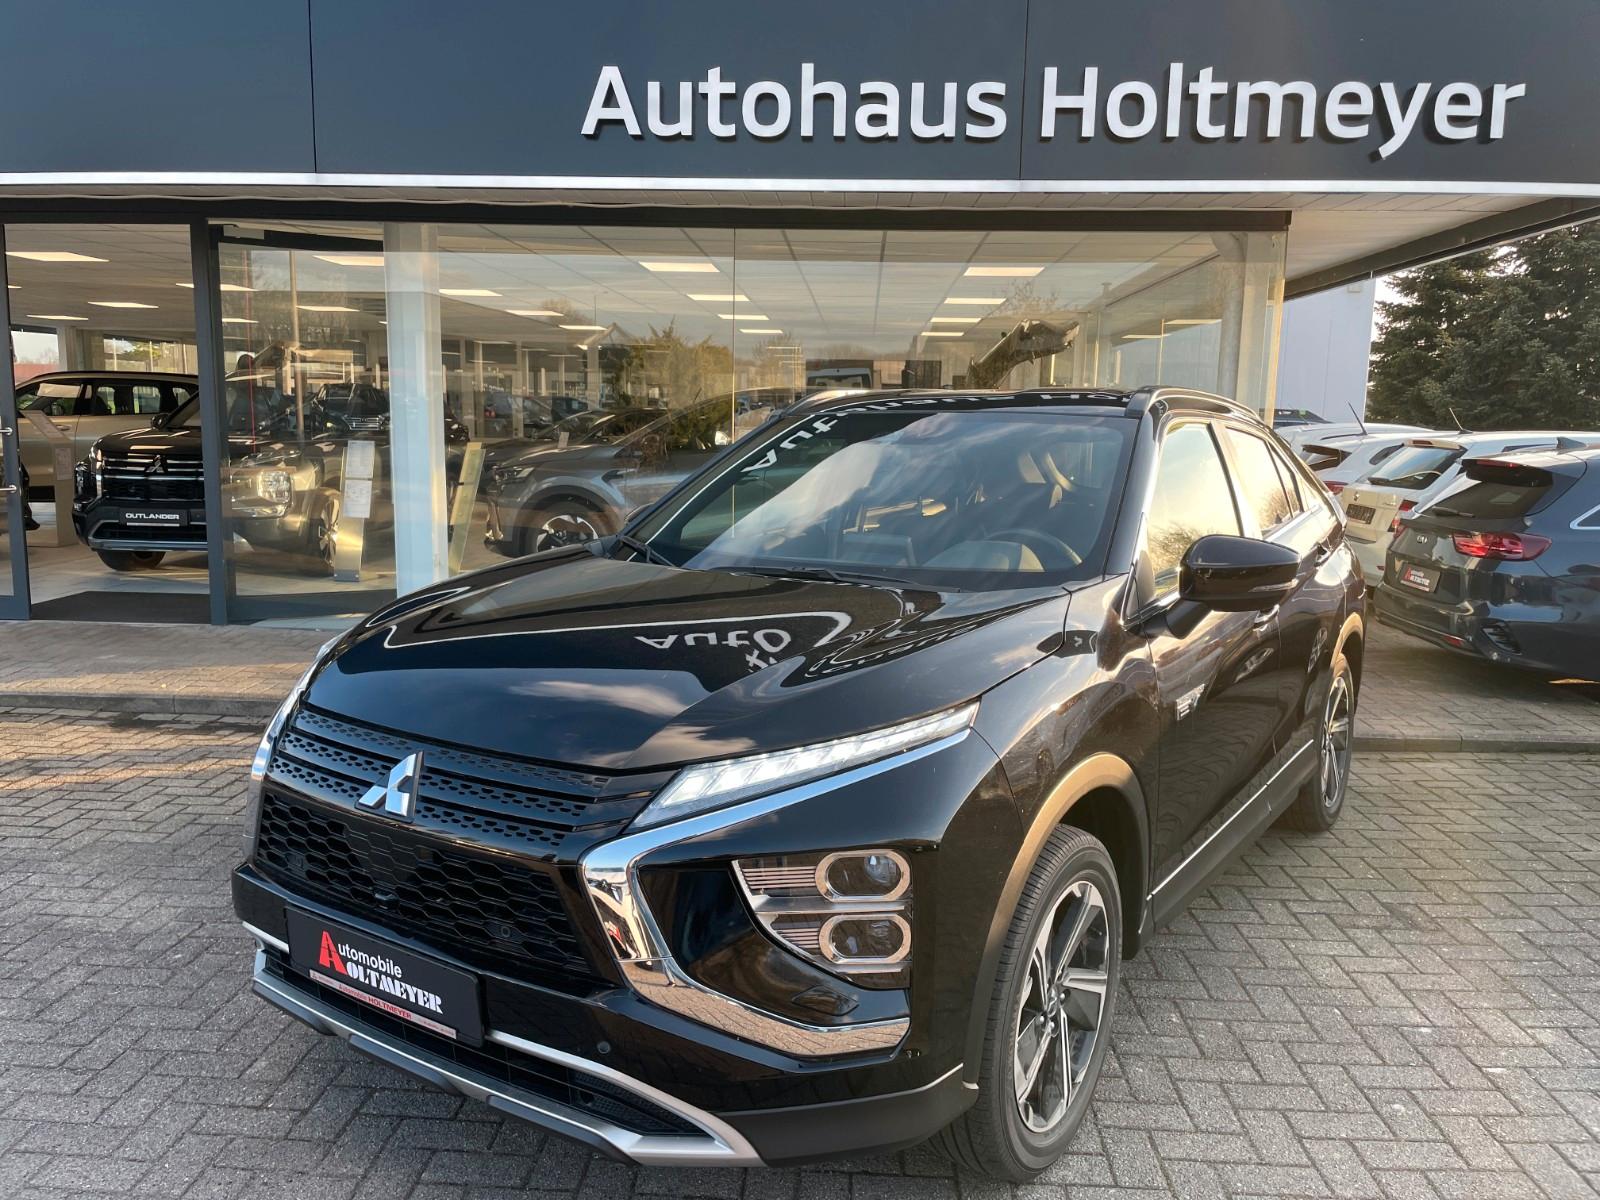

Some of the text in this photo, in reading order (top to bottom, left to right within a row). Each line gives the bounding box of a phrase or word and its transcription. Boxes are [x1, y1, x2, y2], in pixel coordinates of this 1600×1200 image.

[581, 62, 1527, 160] Autohaus Holtmeyer
[125, 512, 180, 520] OUTLANDER
[319, 930, 402, 978] Automobile
